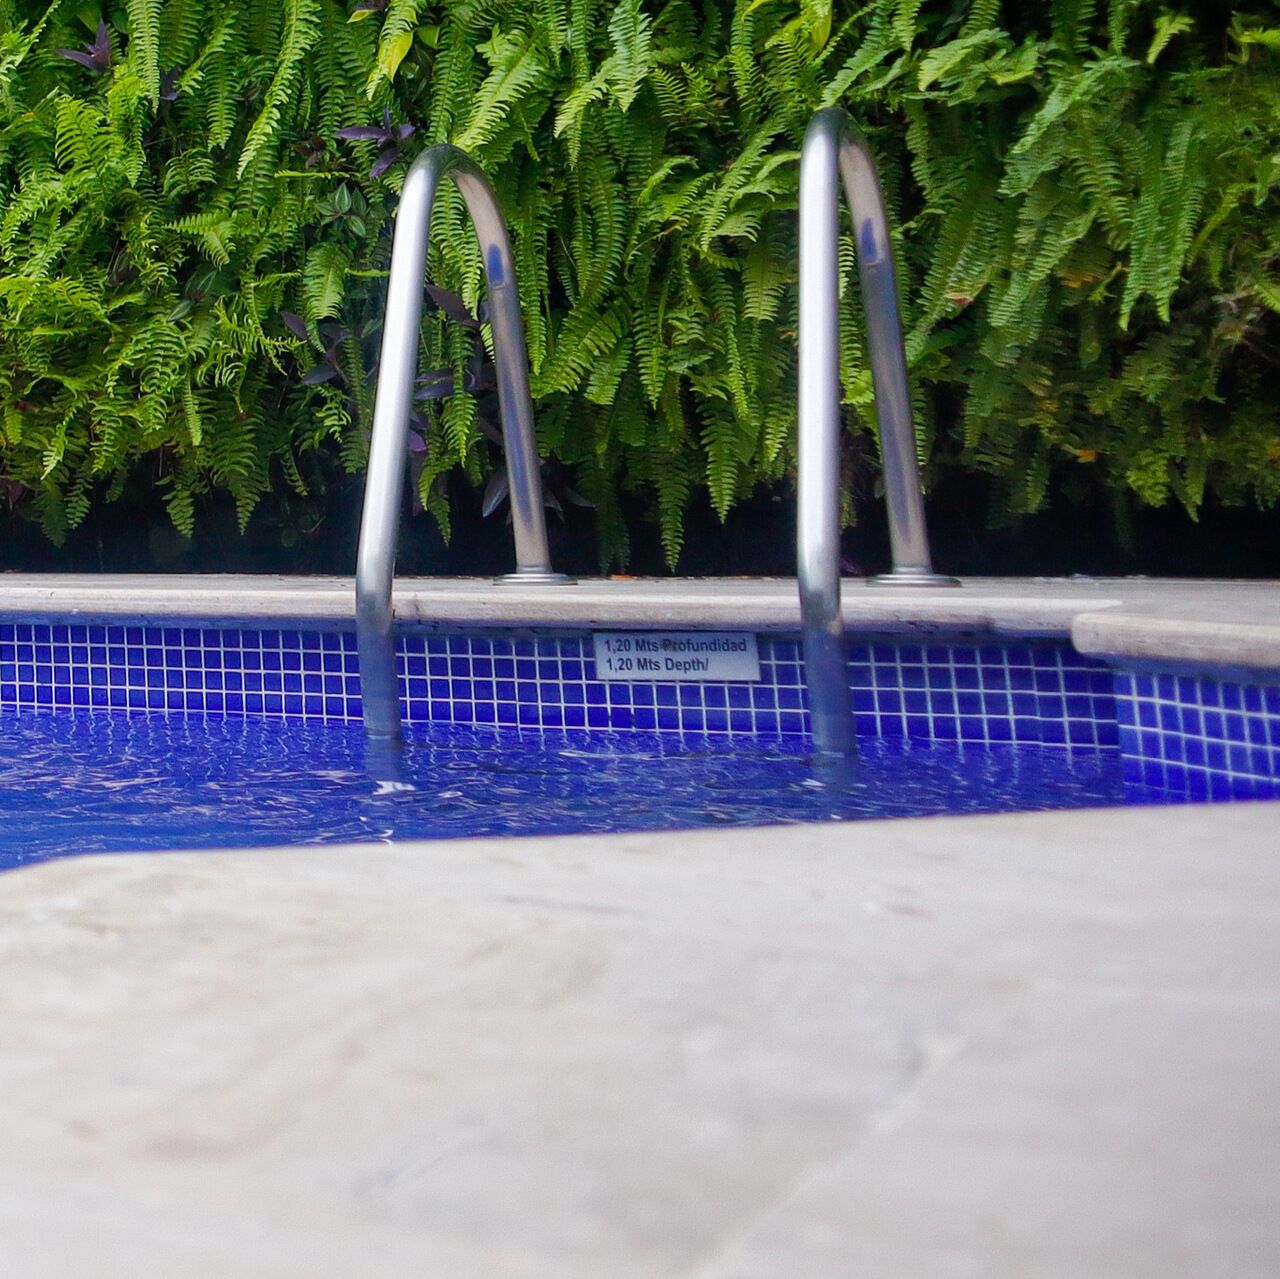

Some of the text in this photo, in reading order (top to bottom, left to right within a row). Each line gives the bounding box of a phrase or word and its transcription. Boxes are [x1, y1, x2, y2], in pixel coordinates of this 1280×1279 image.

[605, 638, 747, 654] 1,20 Mts Profundidad
[606, 658, 633, 673] 1,20
[637, 658, 661, 672] Mts
